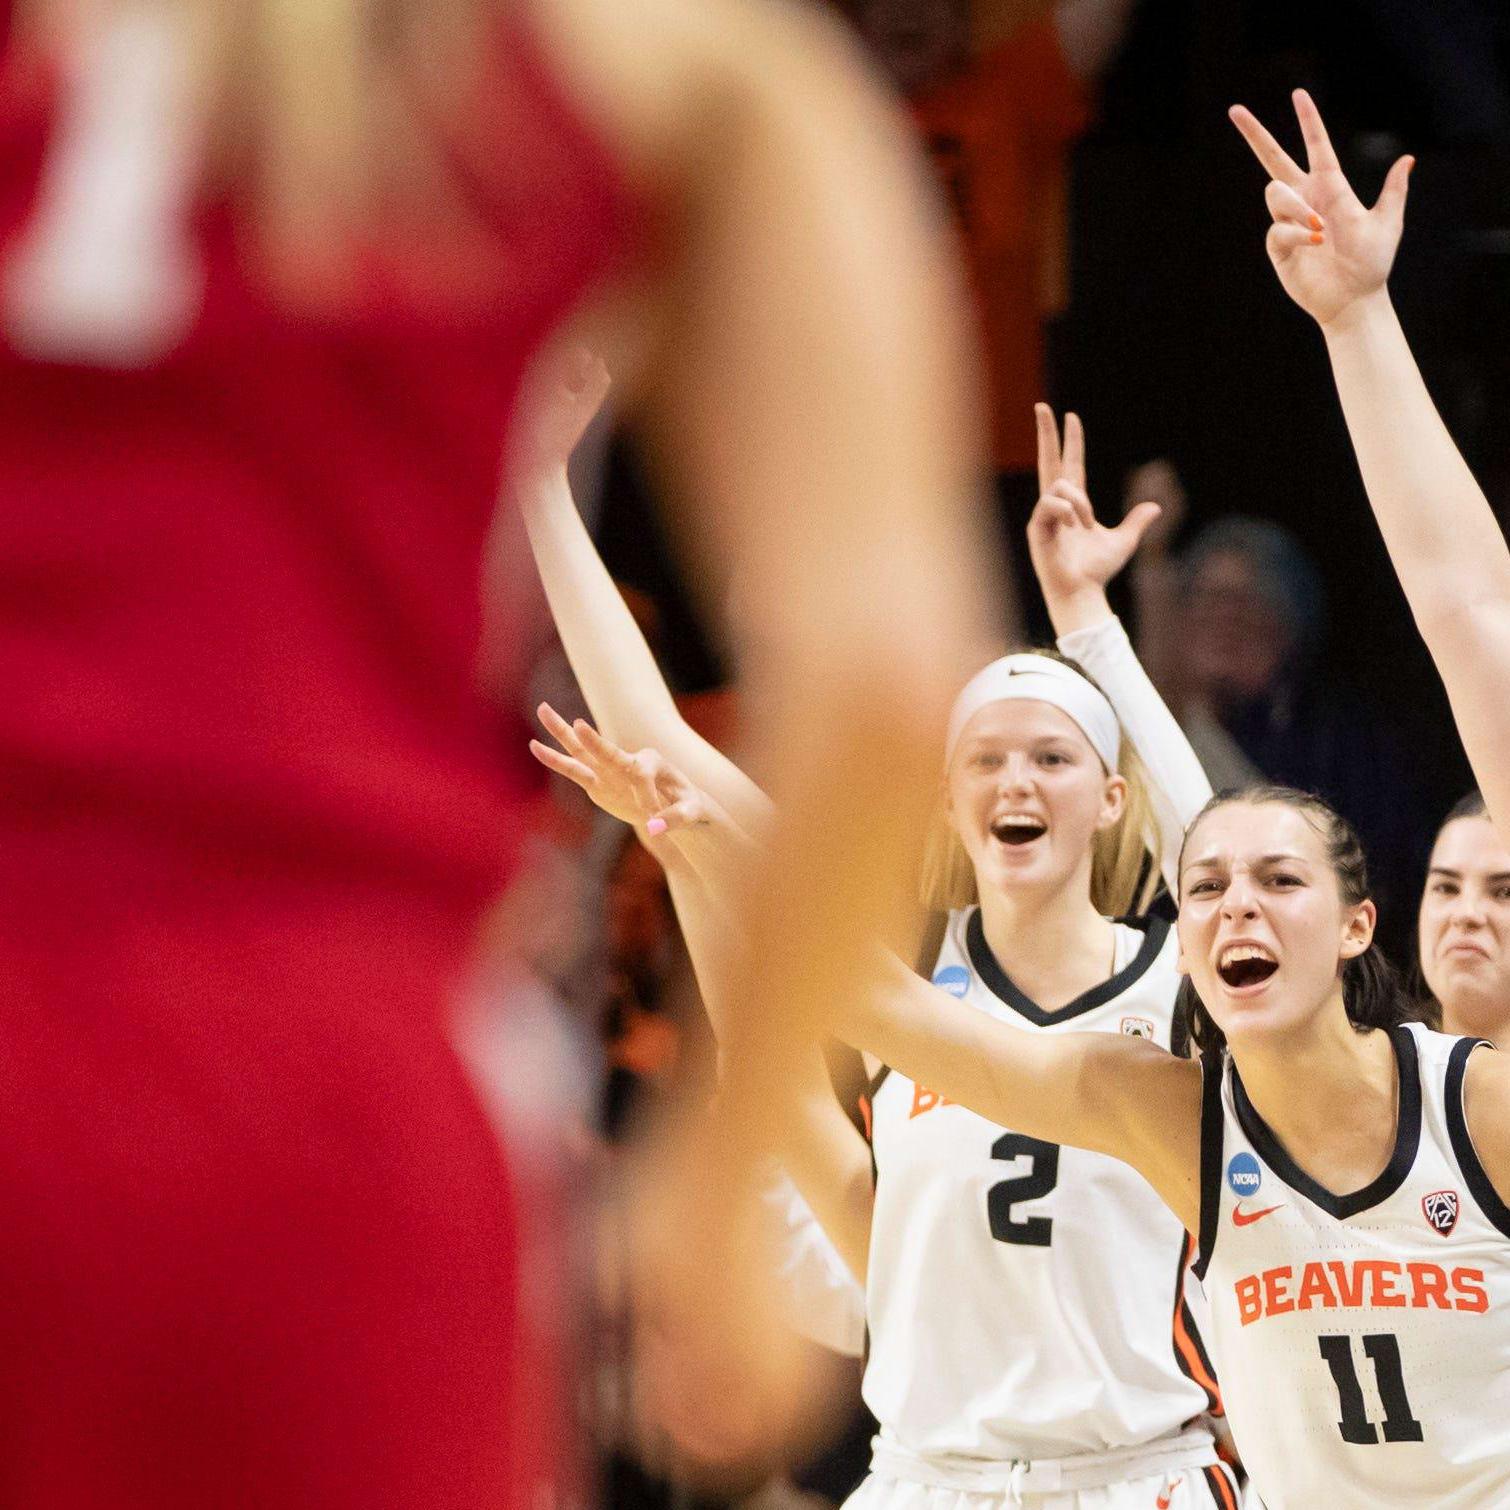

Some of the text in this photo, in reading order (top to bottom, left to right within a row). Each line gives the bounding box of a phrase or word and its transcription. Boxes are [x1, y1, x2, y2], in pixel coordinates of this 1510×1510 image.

[987, 1133, 1060, 1248] 2
[1232, 1173, 1259, 1186] NCAA
[1425, 1193, 1457, 1217] PAC
[1434, 1212, 1452, 1228] 12
[1234, 1260, 1490, 1327] BEAVERS
[1318, 1334, 1424, 1444] 11
